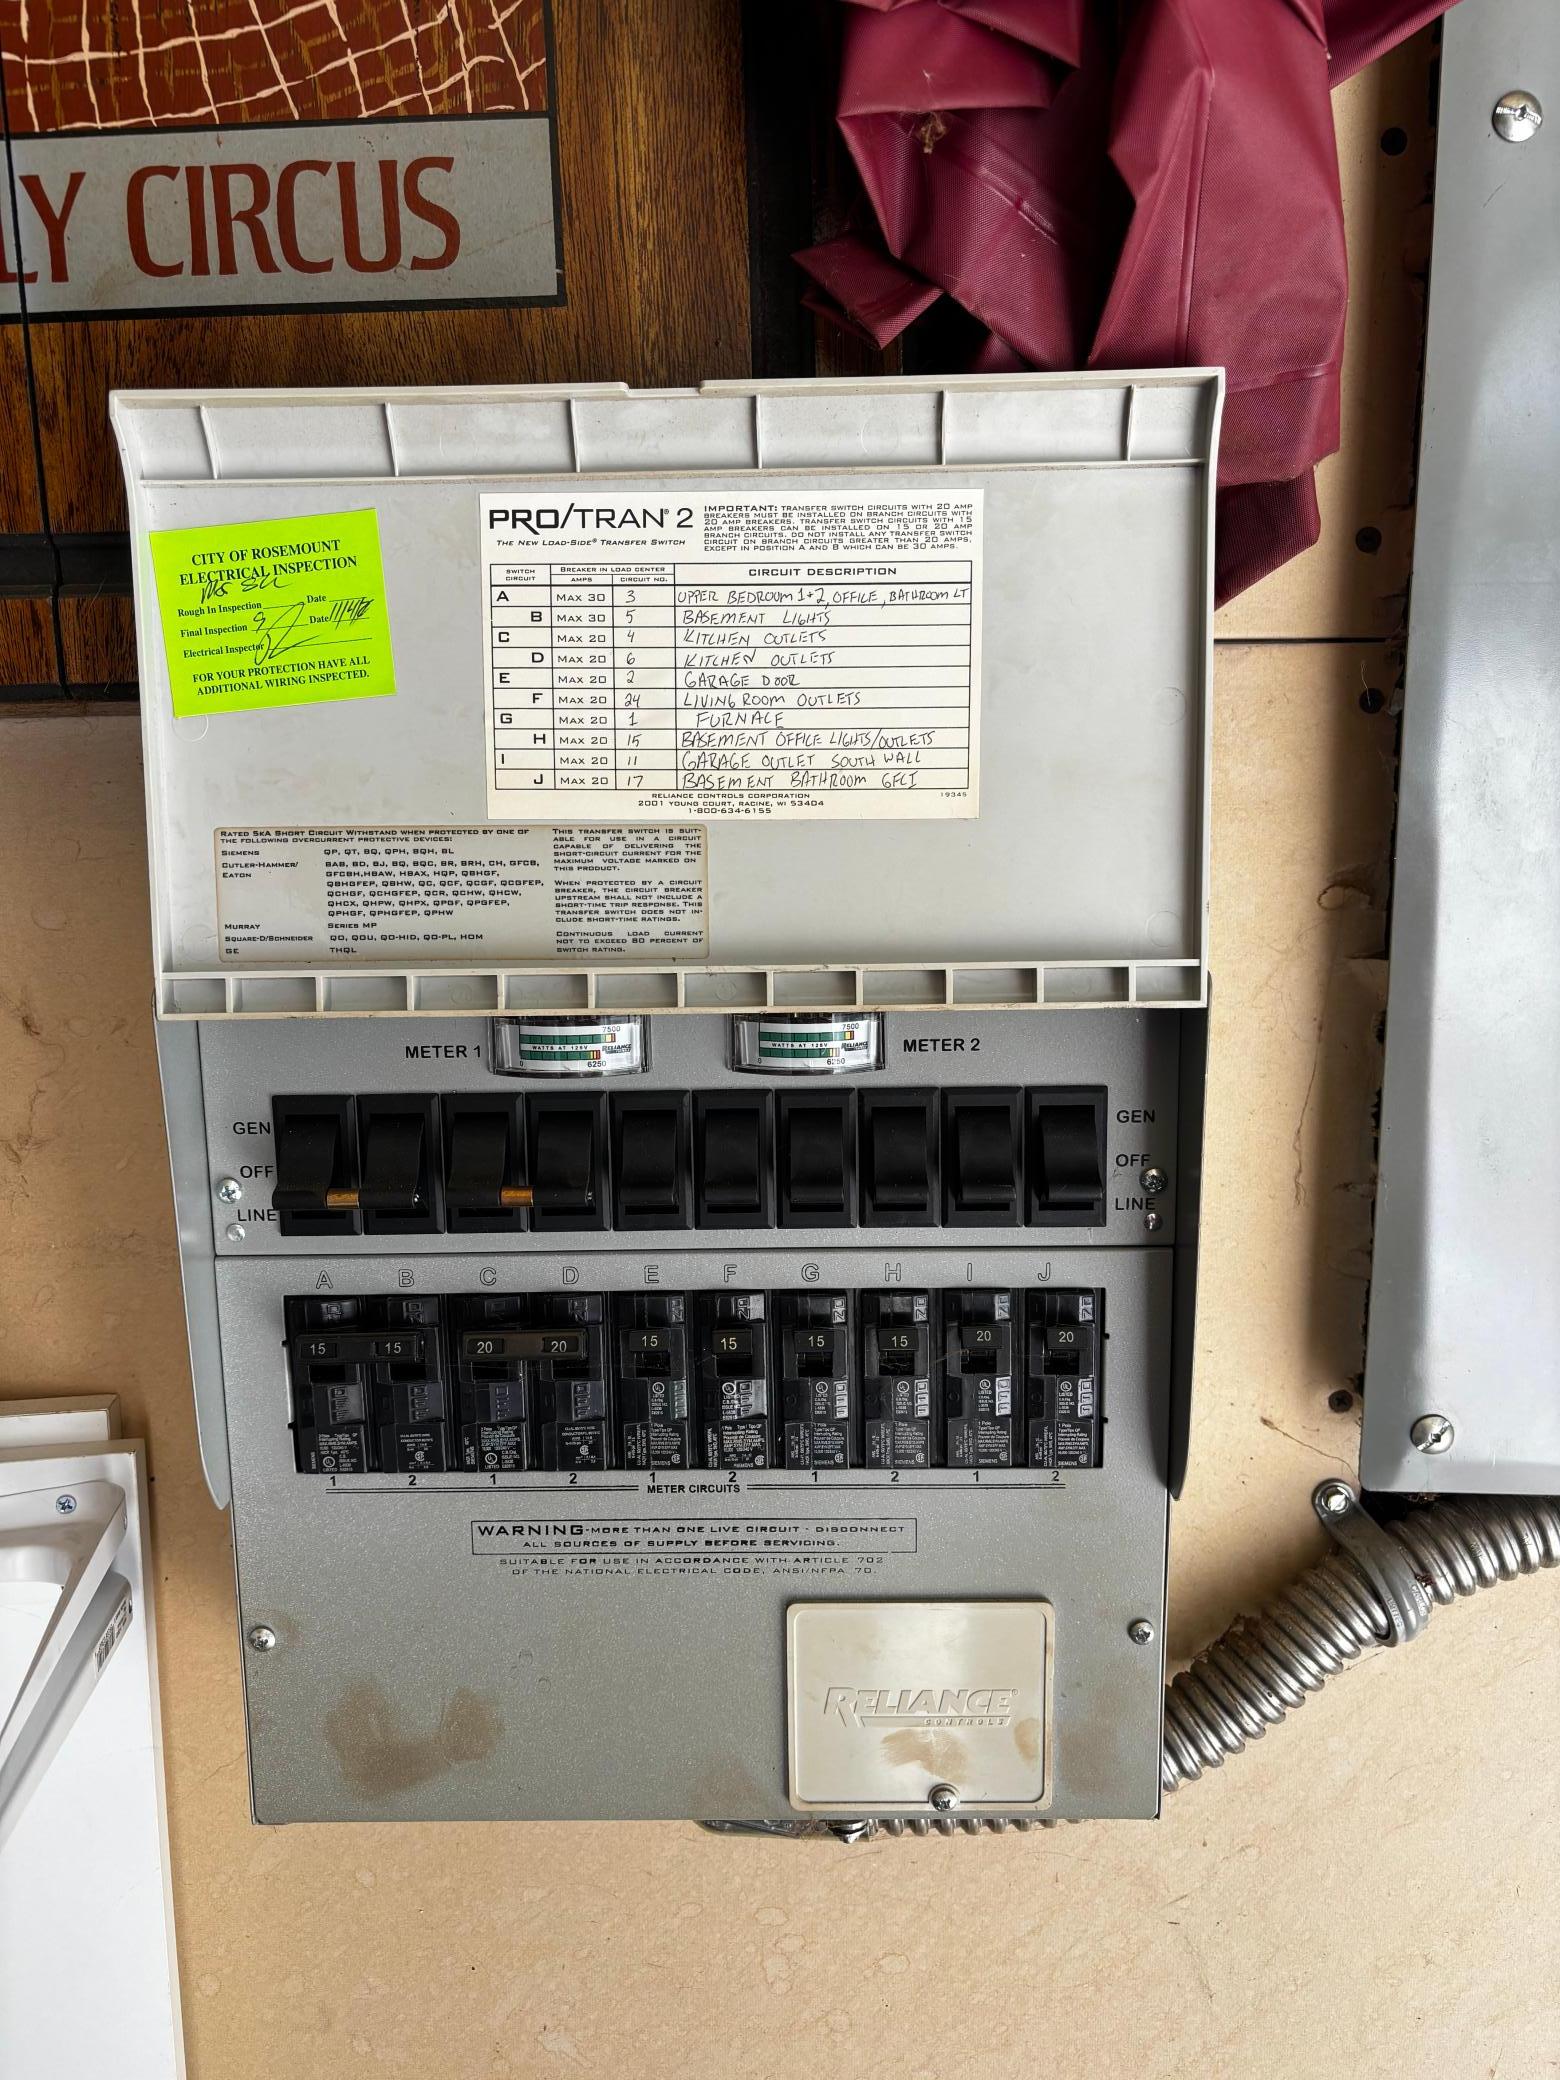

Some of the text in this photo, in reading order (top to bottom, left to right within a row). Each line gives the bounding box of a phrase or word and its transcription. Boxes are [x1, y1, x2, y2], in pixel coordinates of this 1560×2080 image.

[127, 156, 461, 277] CIRCUS
[676, 508, 693, 528] 2
[192, 540, 340, 566] CITY OF ROSEMOUNT
[180, 556, 357, 585] ELECTRICAL INSPECTION
[749, 568, 896, 576] CIRCUIT DESCRIPTION
[307, 594, 326, 603] Date
[496, 591, 509, 601] A
[626, 590, 635, 603] 3
[678, 590, 718, 604] UPPER
[727, 591, 793, 604] BEDROOM
[889, 590, 949, 602] BATHROOM
[954, 588, 969, 598] LT
[178, 608, 204, 617] Rough
[218, 601, 262, 614] Inspection
[310, 614, 329, 624] Date
[531, 611, 542, 621] B
[626, 610, 635, 624] 5
[683, 609, 831, 625] BASEMENT LIGHTS
[180, 623, 247, 637] Final Inspection
[498, 631, 509, 642] C
[627, 630, 634, 642] 4
[684, 628, 827, 646] KITCHEN OUTLETS
[183, 643, 264, 658] Electrical Inspector
[532, 653, 544, 662] D
[627, 652, 635, 665] 6
[684, 649, 835, 667] KITCHEN OUTLETS
[193, 656, 370, 683] FOR YOUR PROTECTION HAVE ALL
[197, 670, 369, 695] ADDITIONAL WIRING INSPECTED.
[500, 673, 510, 683] E
[627, 671, 634, 684] 2
[684, 672, 800, 688] GARAGE DOOR
[533, 693, 543, 703] F
[625, 694, 640, 707] 24
[684, 692, 861, 708] LIVING ROOM OUTLETS
[500, 713, 513, 723] G
[629, 714, 638, 726] 1
[696, 712, 784, 728] FURNACE
[534, 734, 546, 744] H
[628, 734, 642, 746] 15
[682, 730, 936, 749] BASEMENT OFFICE LIGHTS/OUTLETS
[501, 754, 505, 764] I
[628, 755, 637, 766] 11
[682, 751, 920, 770] GARAGE OUTLET SOUTH WALL
[534, 774, 543, 784] J
[628, 776, 643, 787] 17
[682, 771, 918, 788] BASEMENT BATHROOM GFCI
[405, 1045, 481, 1059] METER 1
[903, 1039, 980, 1053] METER 2
[1116, 1110, 1155, 1123] GEN
[233, 1121, 271, 1135] GEN
[1116, 1154, 1151, 1167] OFF
[240, 1166, 274, 1178] OFF
[1115, 1198, 1156, 1210] LINE
[238, 1209, 277, 1221] LINE
[480, 1268, 497, 1285] C
[562, 1267, 579, 1284] D
[645, 1265, 659, 1283] E
[723, 1264, 738, 1282] F
[802, 1264, 820, 1282] G
[885, 1263, 901, 1281] H
[967, 1263, 973, 1280] I
[1038, 1263, 1052, 1281] J
[316, 1271, 333, 1288] A
[398, 1270, 414, 1287] B
[642, 1336, 658, 1347] 15
[808, 1336, 825, 1347] 15
[892, 1336, 908, 1347] 15
[976, 1331, 991, 1342] 20
[1059, 1332, 1074, 1342] 20
[310, 1344, 326, 1354] 15
[385, 1342, 401, 1354] 15
[477, 1342, 493, 1354] 20
[551, 1341, 567, 1352] 20
[721, 1338, 737, 1350] 15
[648, 1484, 740, 1493] METER CIRCUITS
